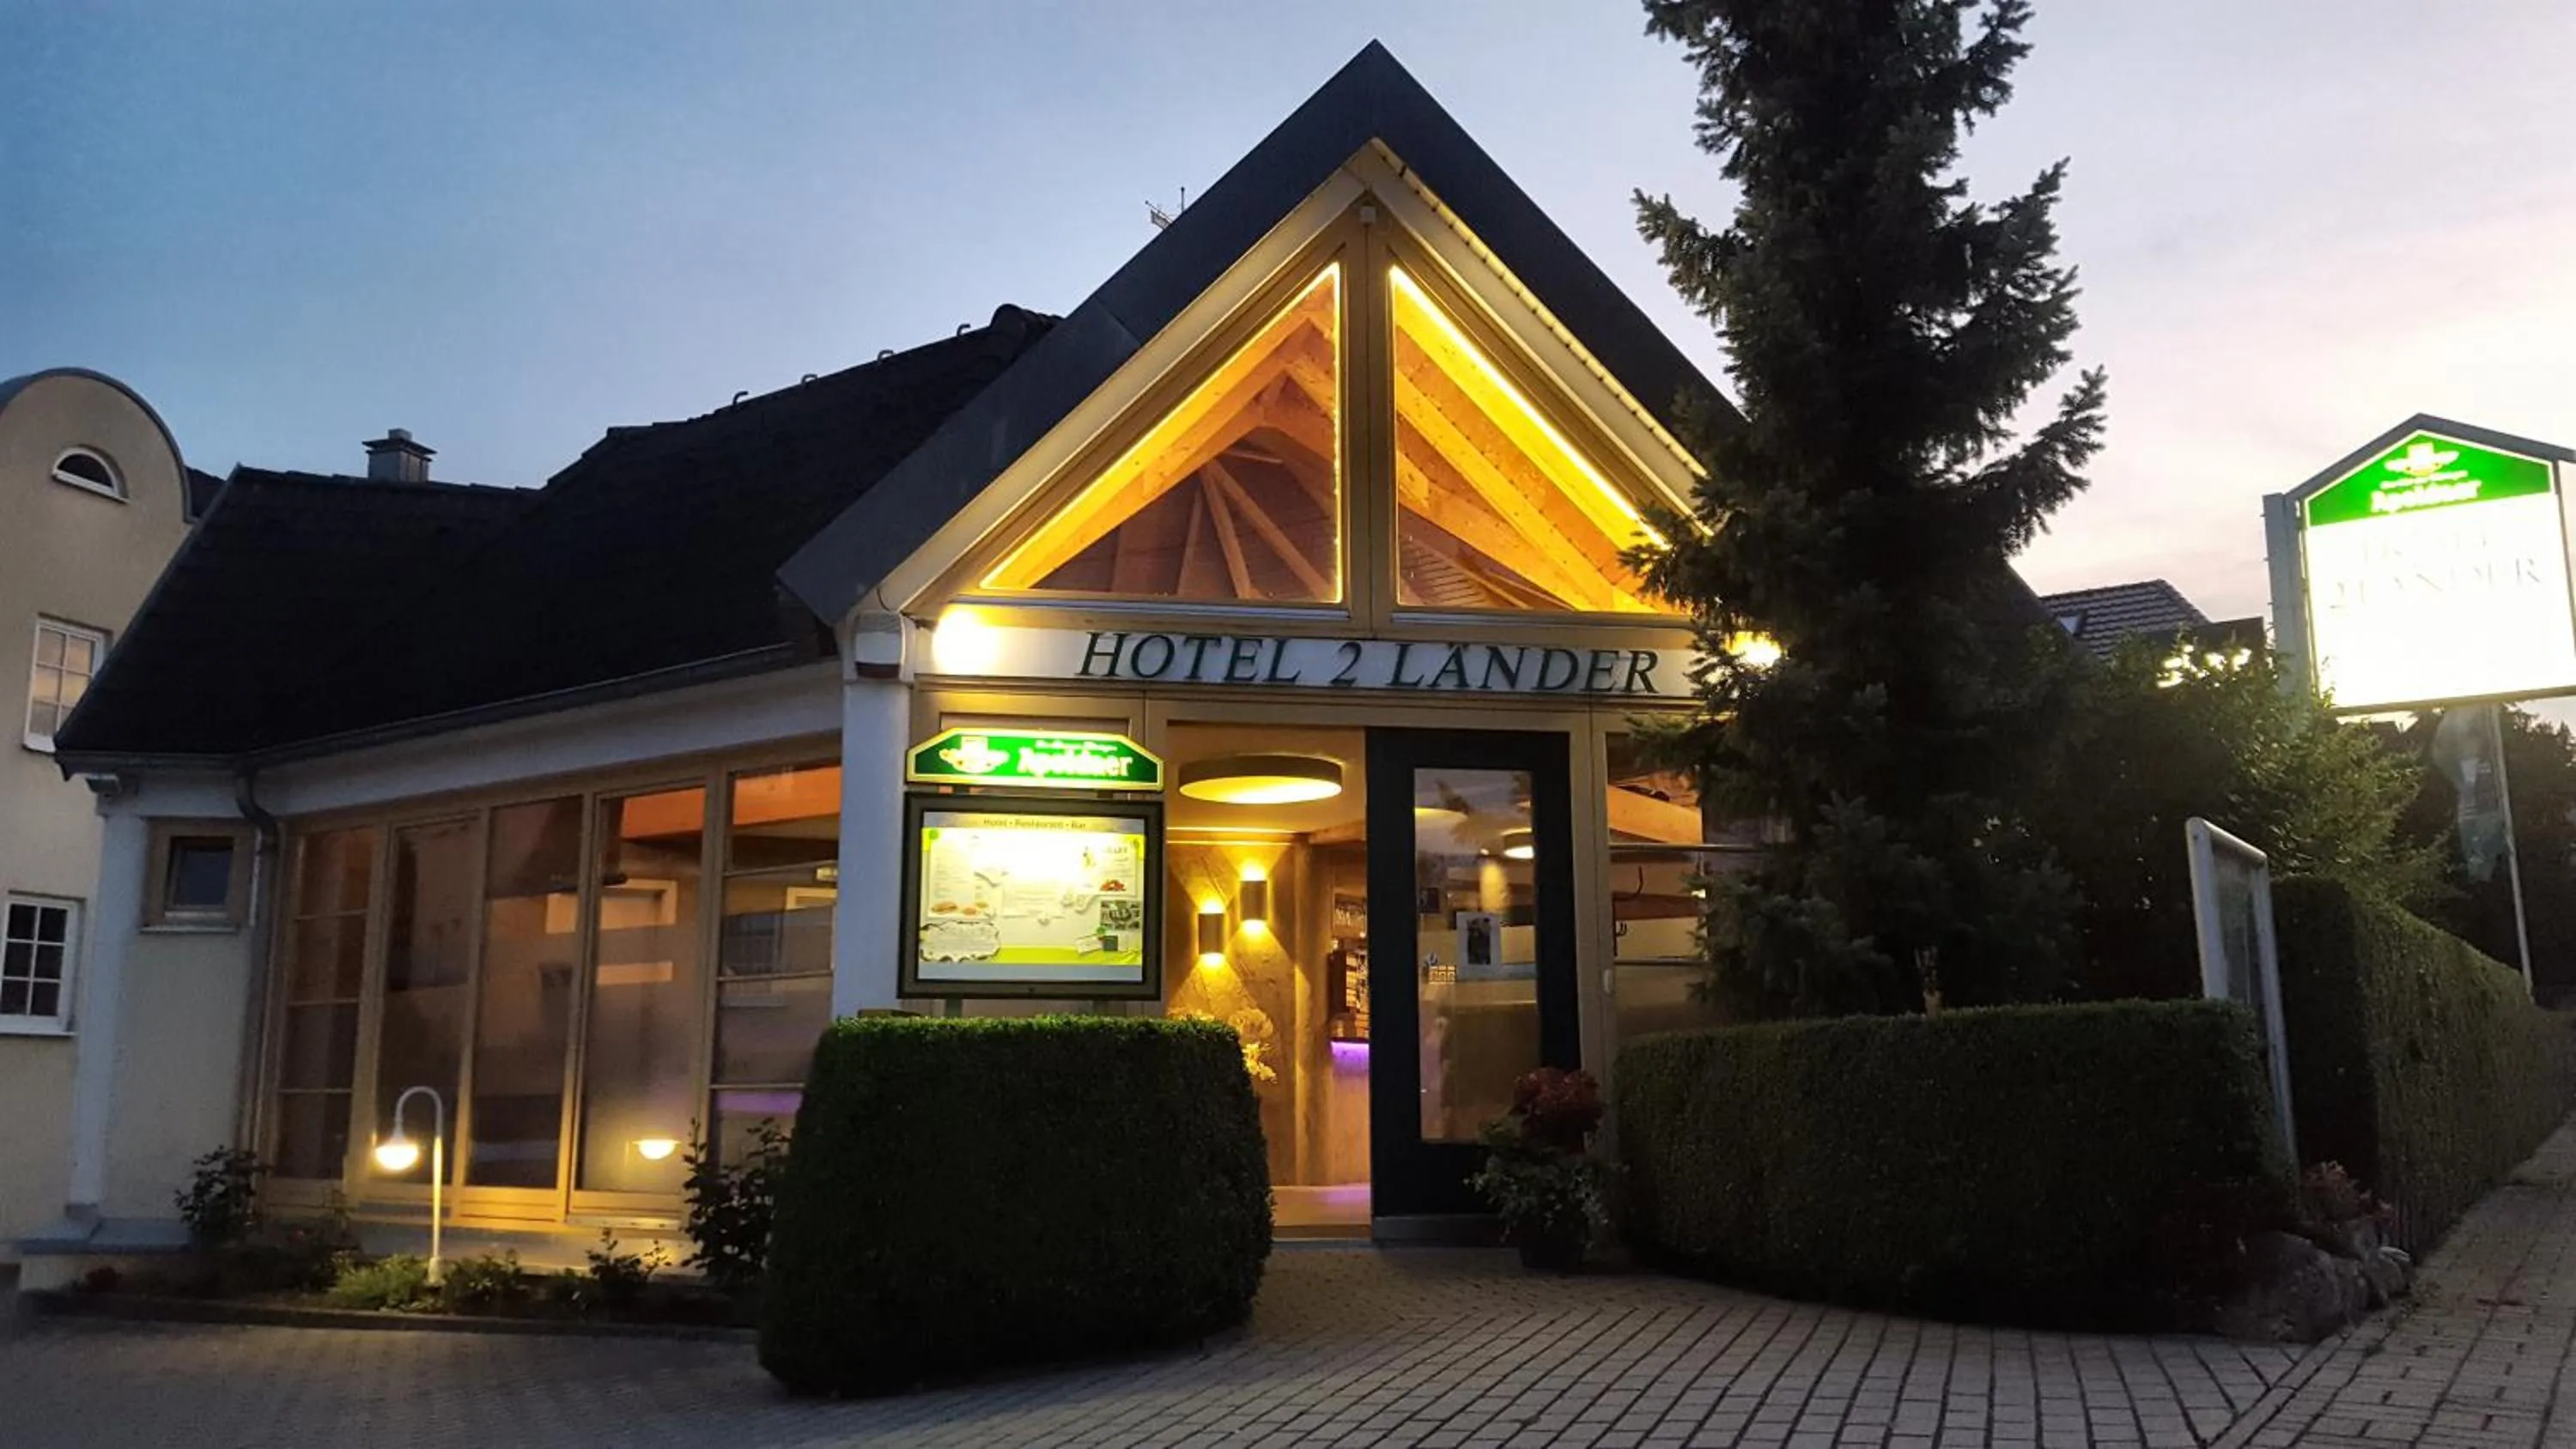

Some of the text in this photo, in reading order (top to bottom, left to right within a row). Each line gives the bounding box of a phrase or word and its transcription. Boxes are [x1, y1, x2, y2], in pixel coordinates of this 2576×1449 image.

[1075, 631, 1660, 694] HOTEL 2 LÄNDER
